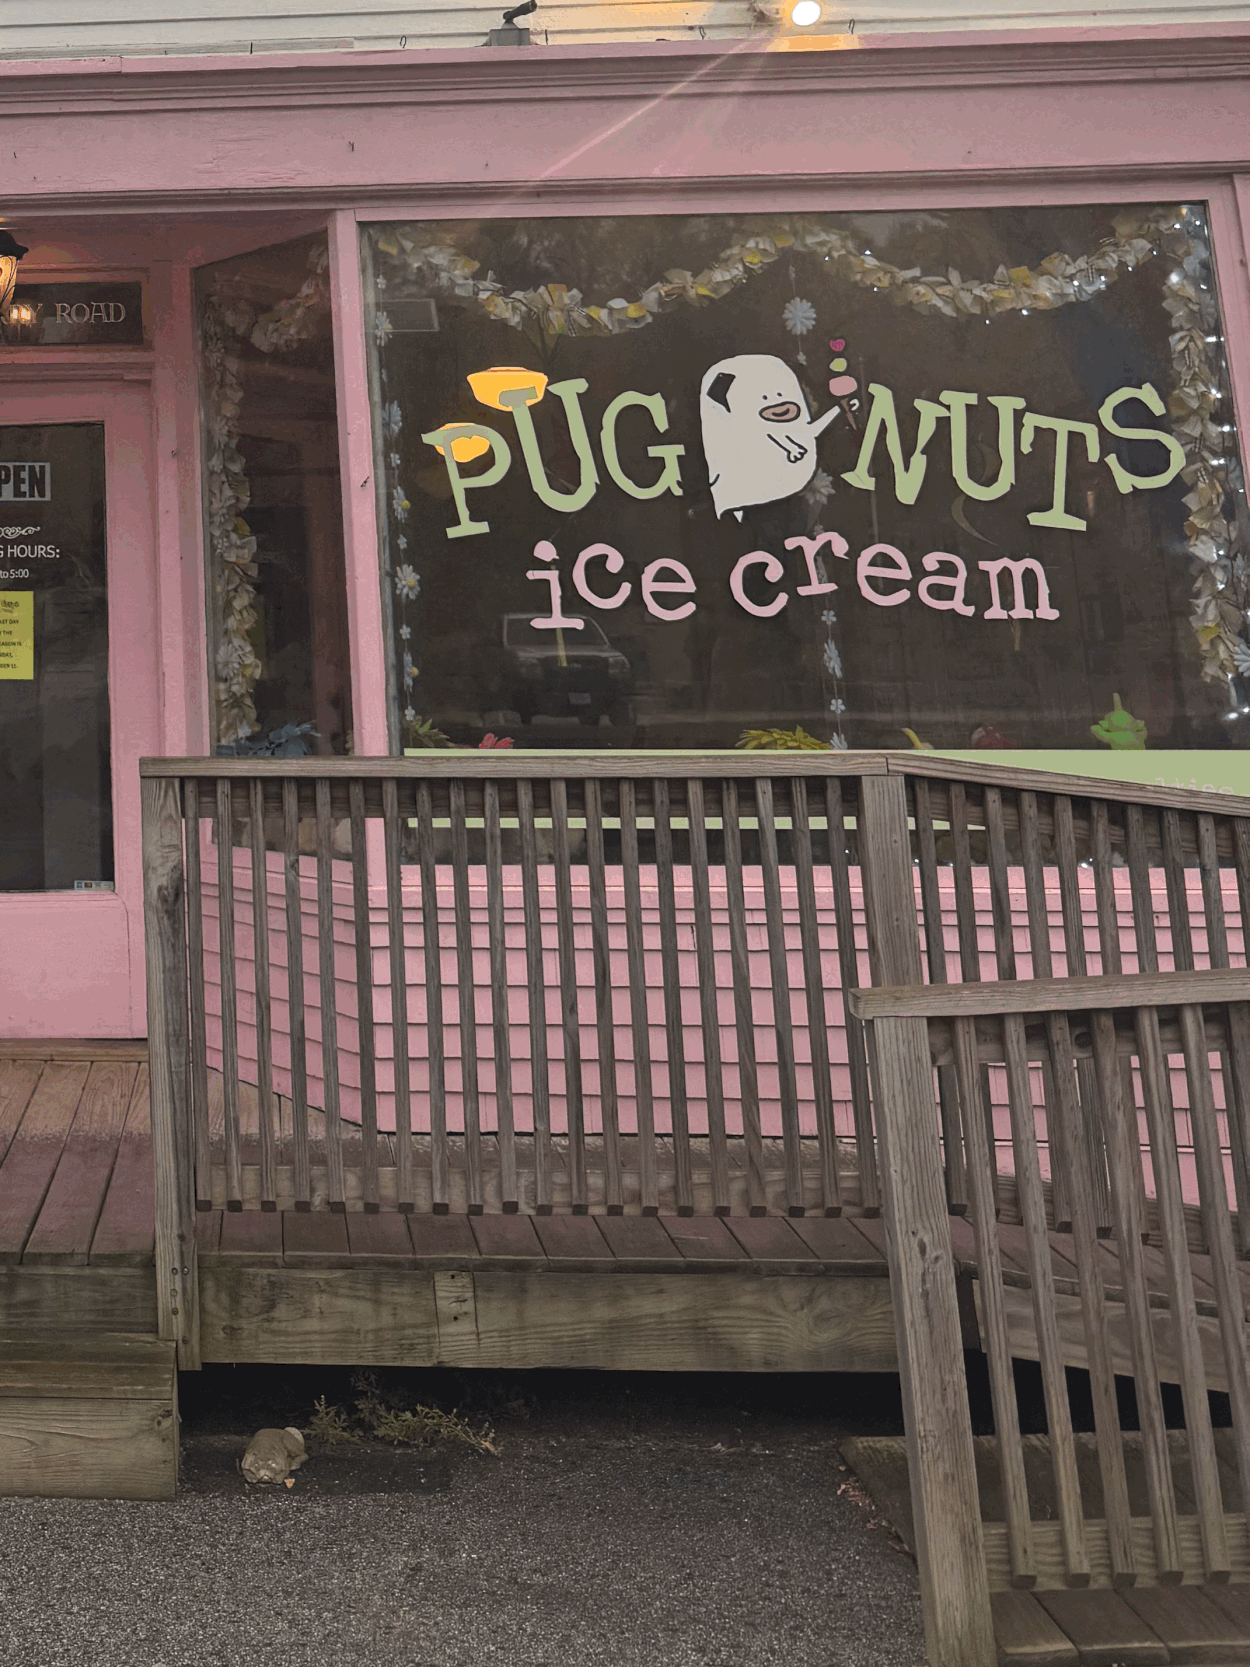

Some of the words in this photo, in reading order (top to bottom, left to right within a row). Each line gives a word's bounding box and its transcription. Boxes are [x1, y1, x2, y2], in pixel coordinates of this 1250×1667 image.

[55, 301, 126, 324] ROAD
[421, 378, 685, 538] PUG
[840, 383, 1187, 532] NUTS
[7, 544, 60, 559] HOURS:
[0, 569, 9, 579] to
[10, 568, 30, 579] 5:00
[526, 540, 696, 630] ice
[730, 532, 1059, 622] cream
